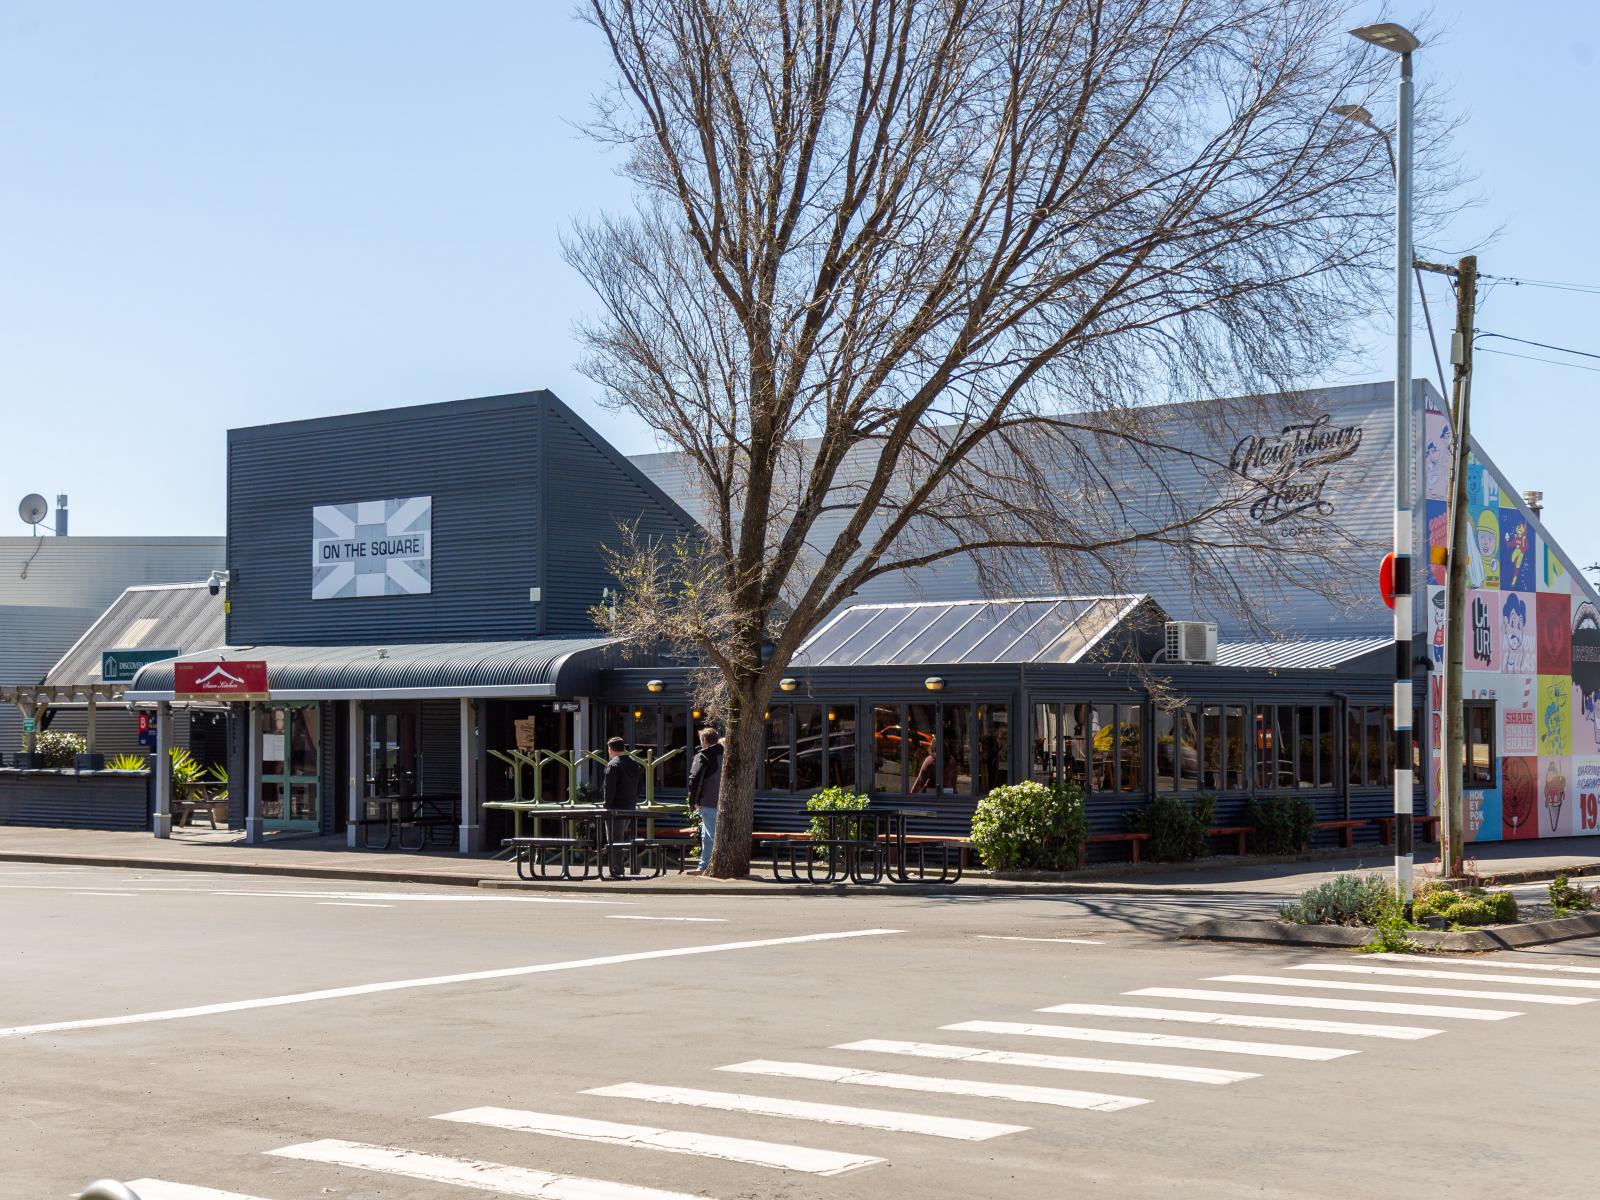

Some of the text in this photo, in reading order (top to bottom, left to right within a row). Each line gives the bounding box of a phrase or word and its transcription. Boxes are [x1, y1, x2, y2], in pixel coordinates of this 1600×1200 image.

[323, 538, 420, 560] ON THE SQUARE
[1506, 712, 1533, 725] SHAKE
